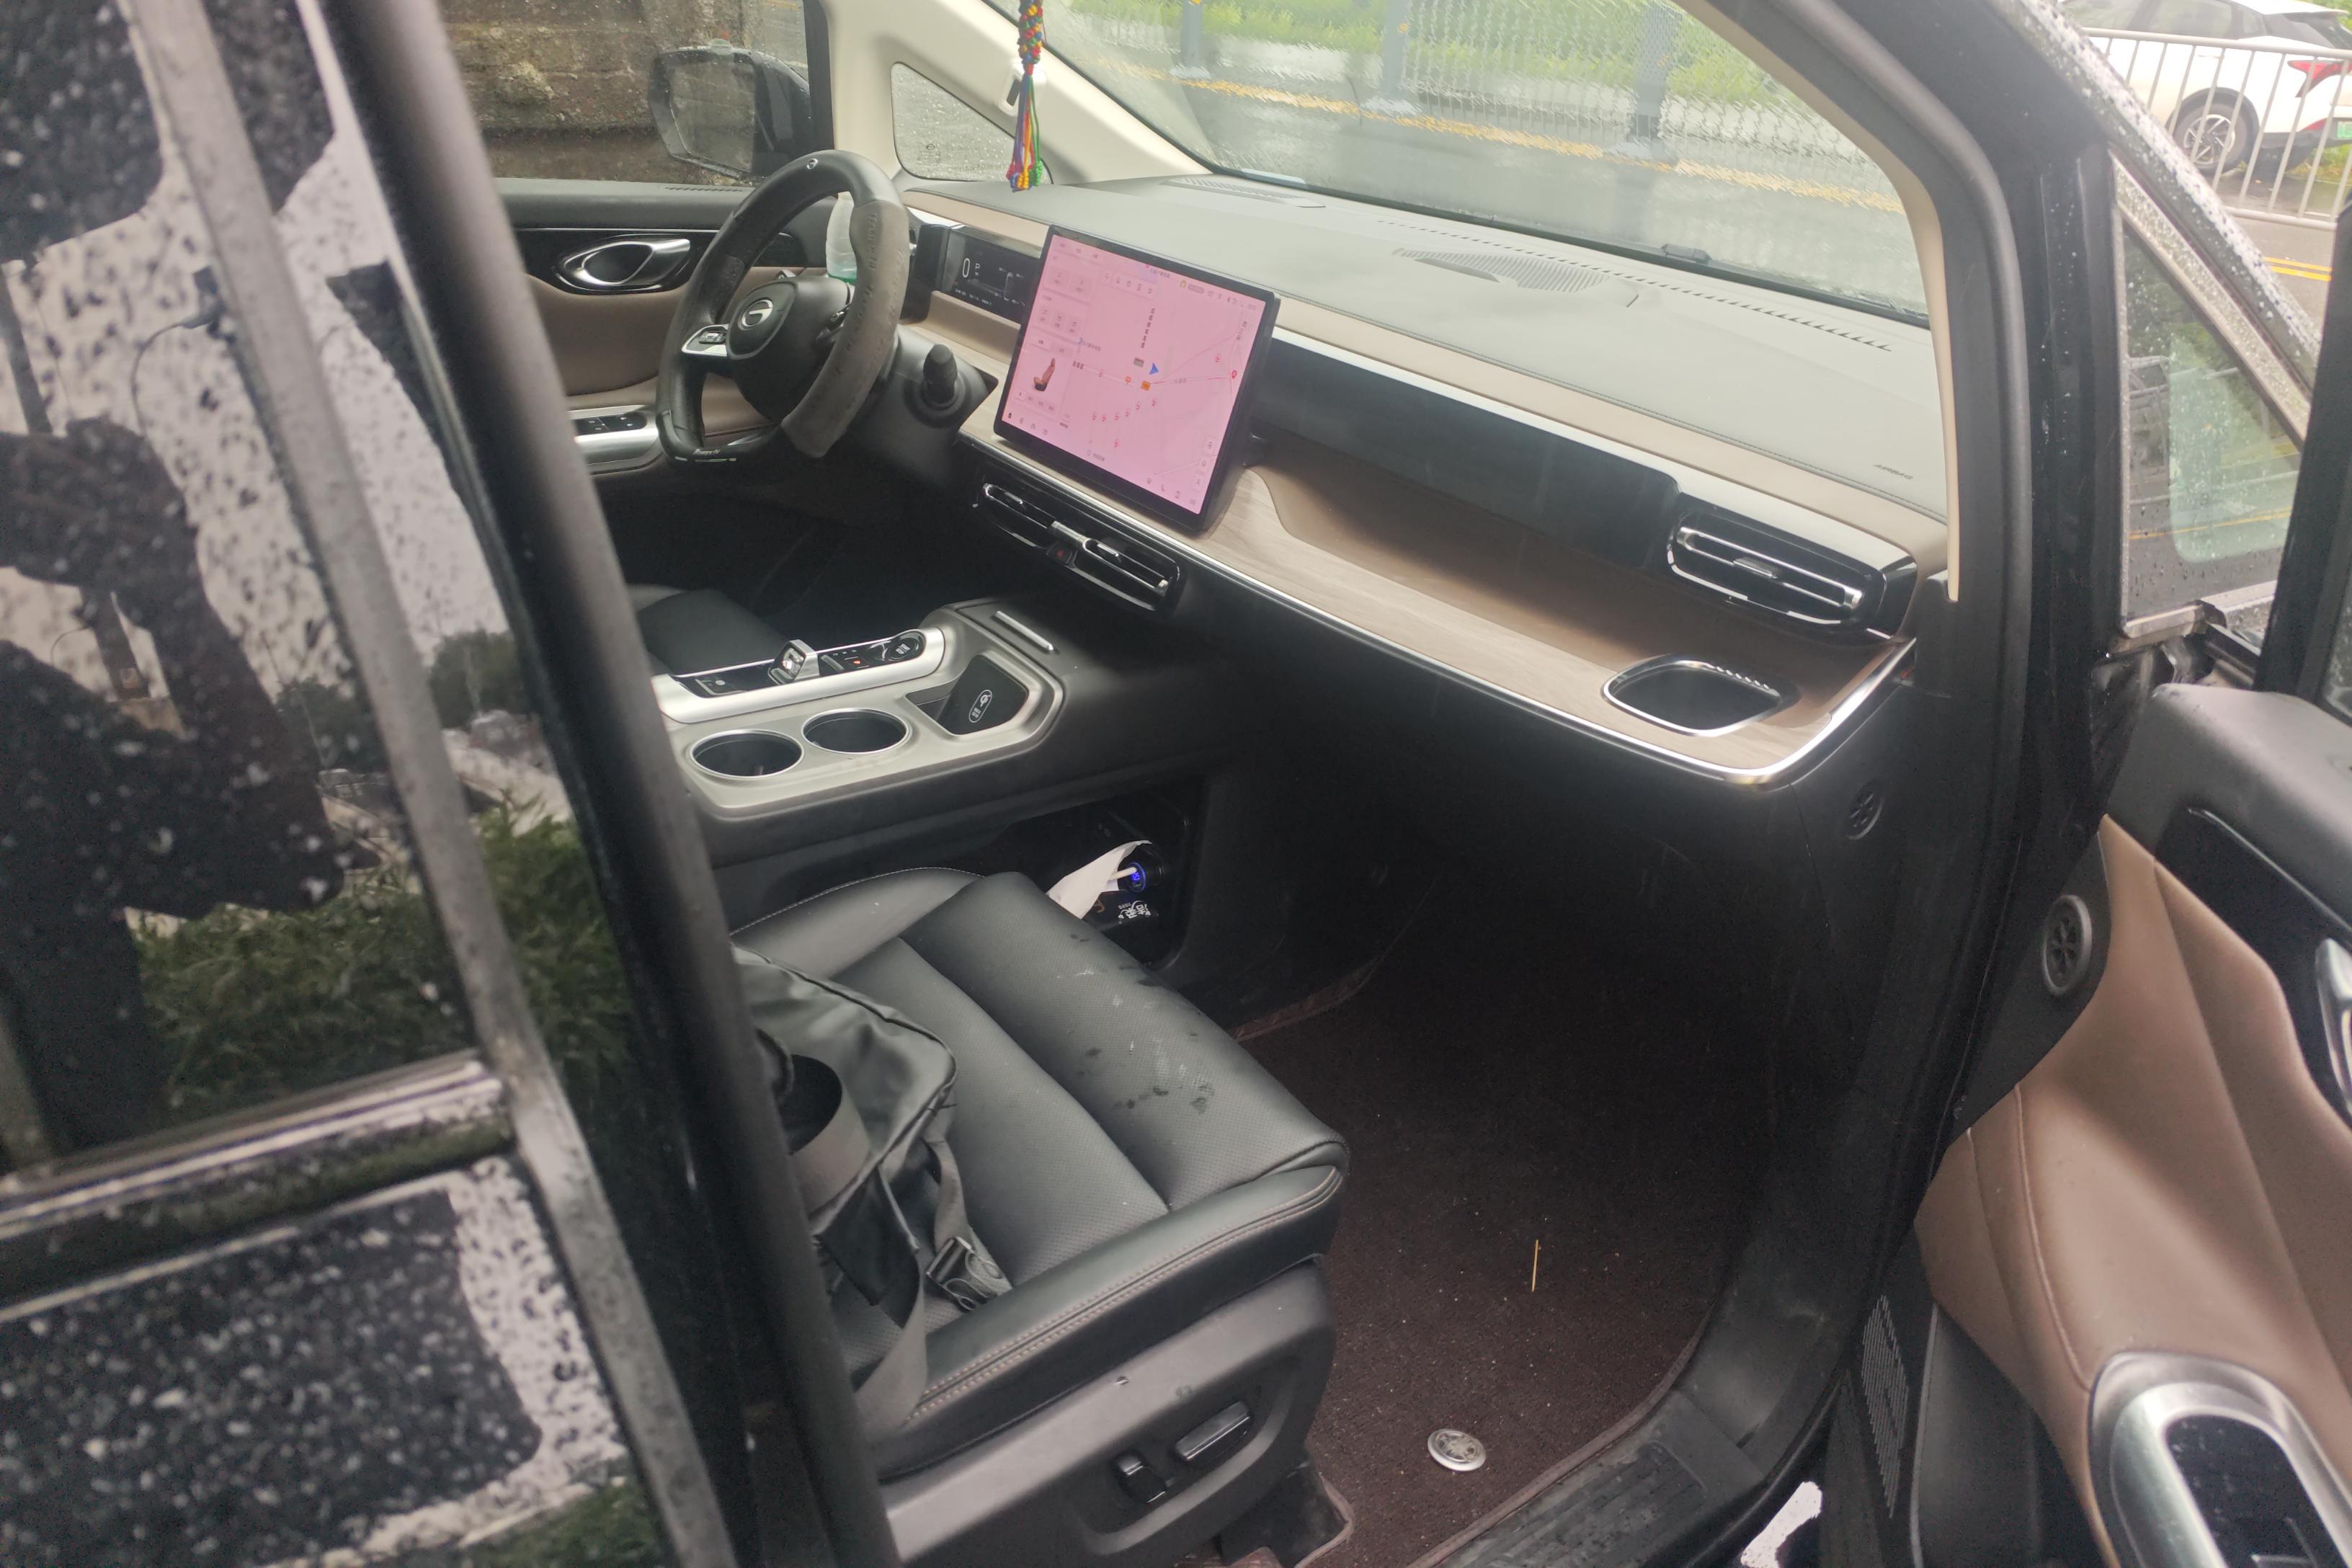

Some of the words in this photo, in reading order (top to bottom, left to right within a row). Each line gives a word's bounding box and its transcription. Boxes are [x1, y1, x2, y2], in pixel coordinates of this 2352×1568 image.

[963, 258, 970, 277] 0
[1874, 464, 1914, 480] AIRBAG
[1120, 900, 1151, 919] 洁柔
